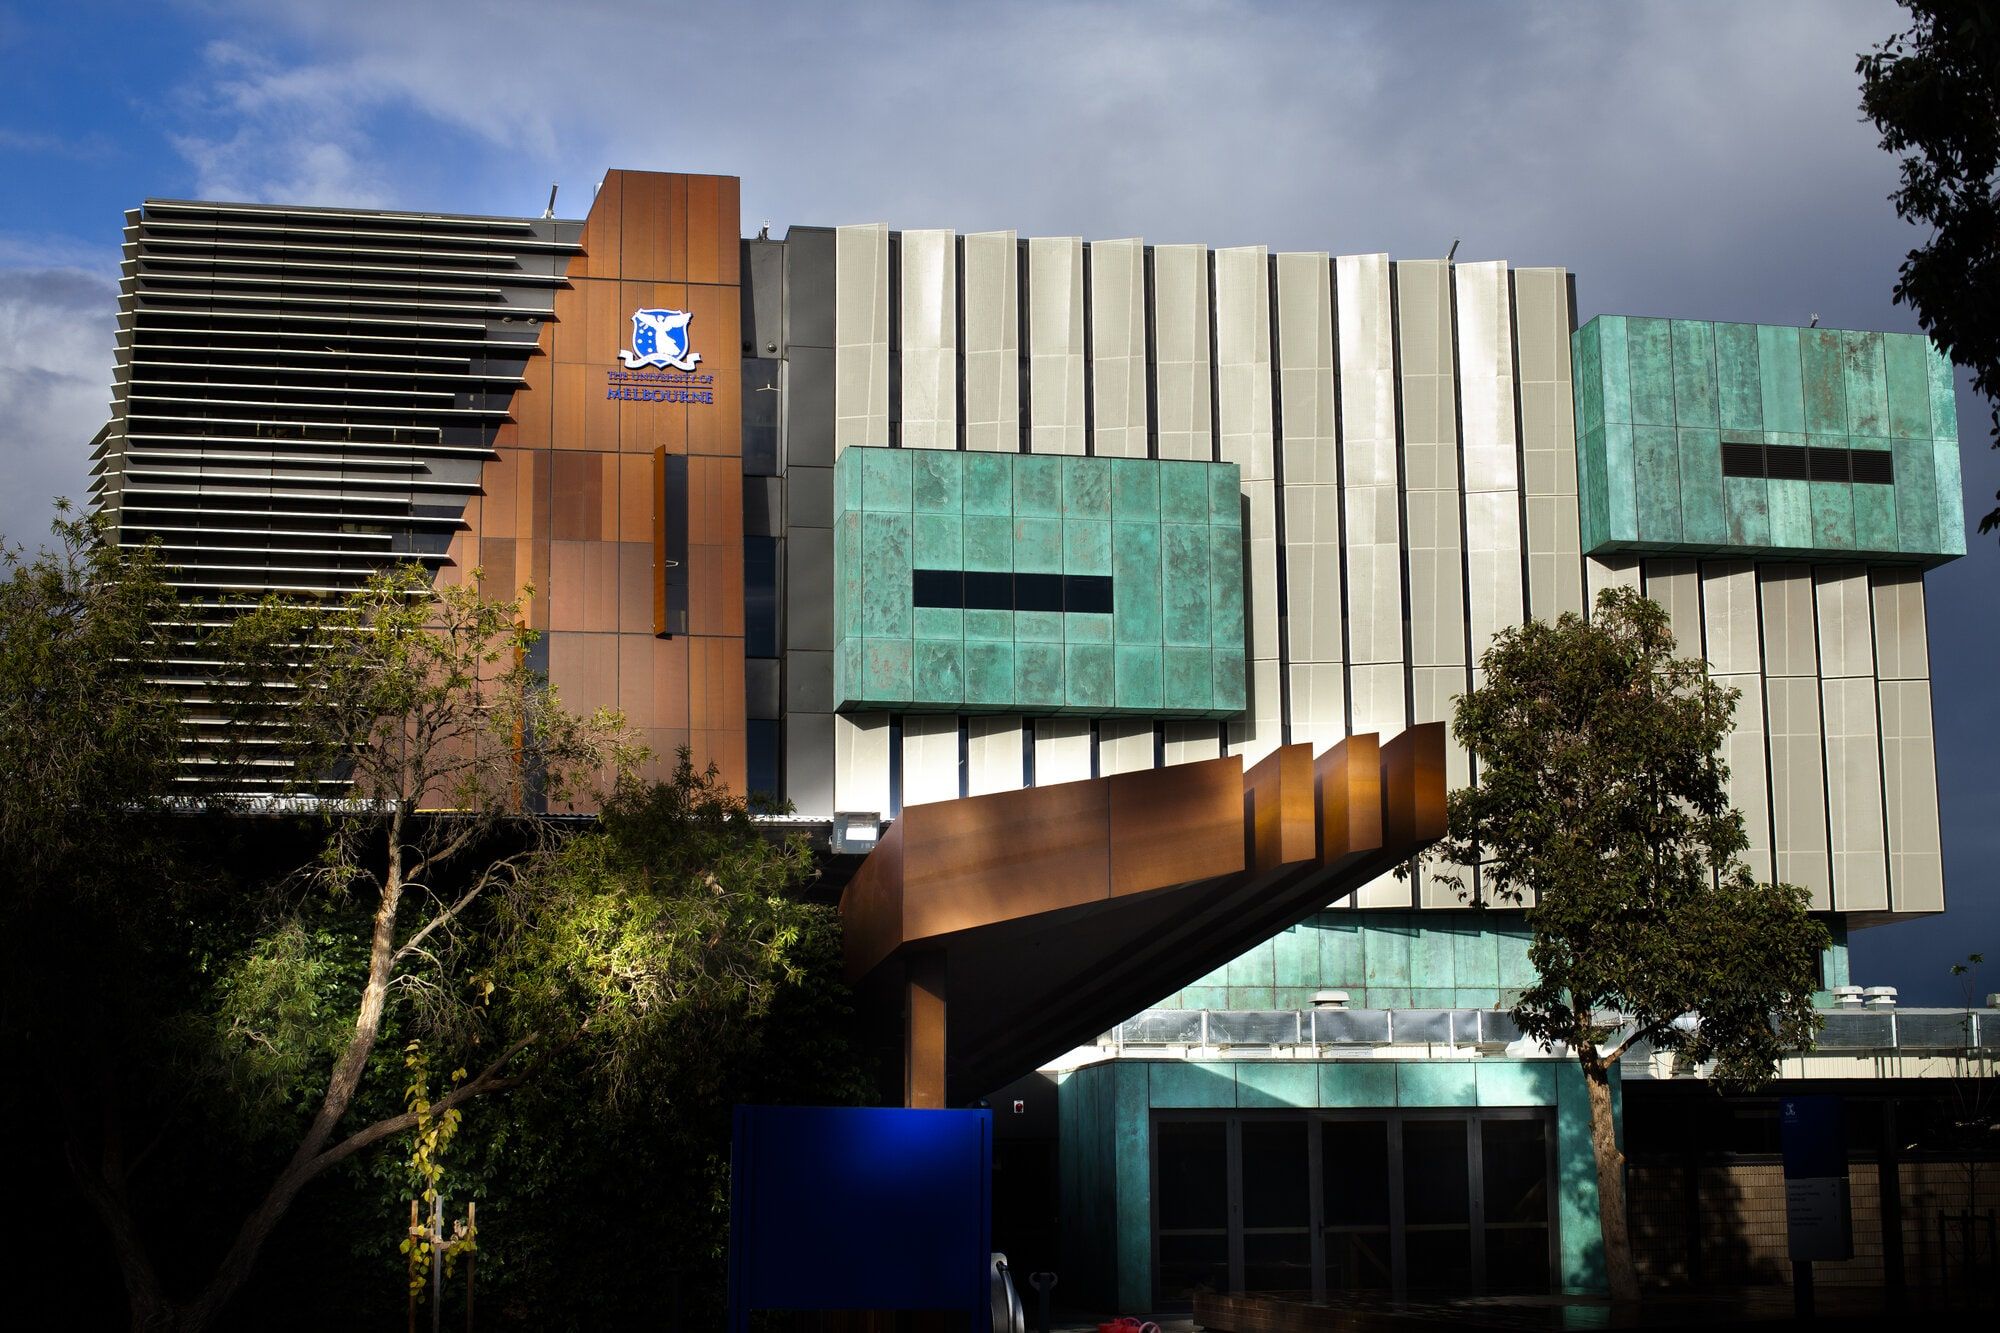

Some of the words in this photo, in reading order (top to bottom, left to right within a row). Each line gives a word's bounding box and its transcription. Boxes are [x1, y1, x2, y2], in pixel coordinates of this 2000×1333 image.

[608, 371, 628, 380] THE
[631, 372, 696, 383] UNIVERSITY
[699, 375, 713, 384] OF
[607, 388, 713, 404] MELBOURNE
